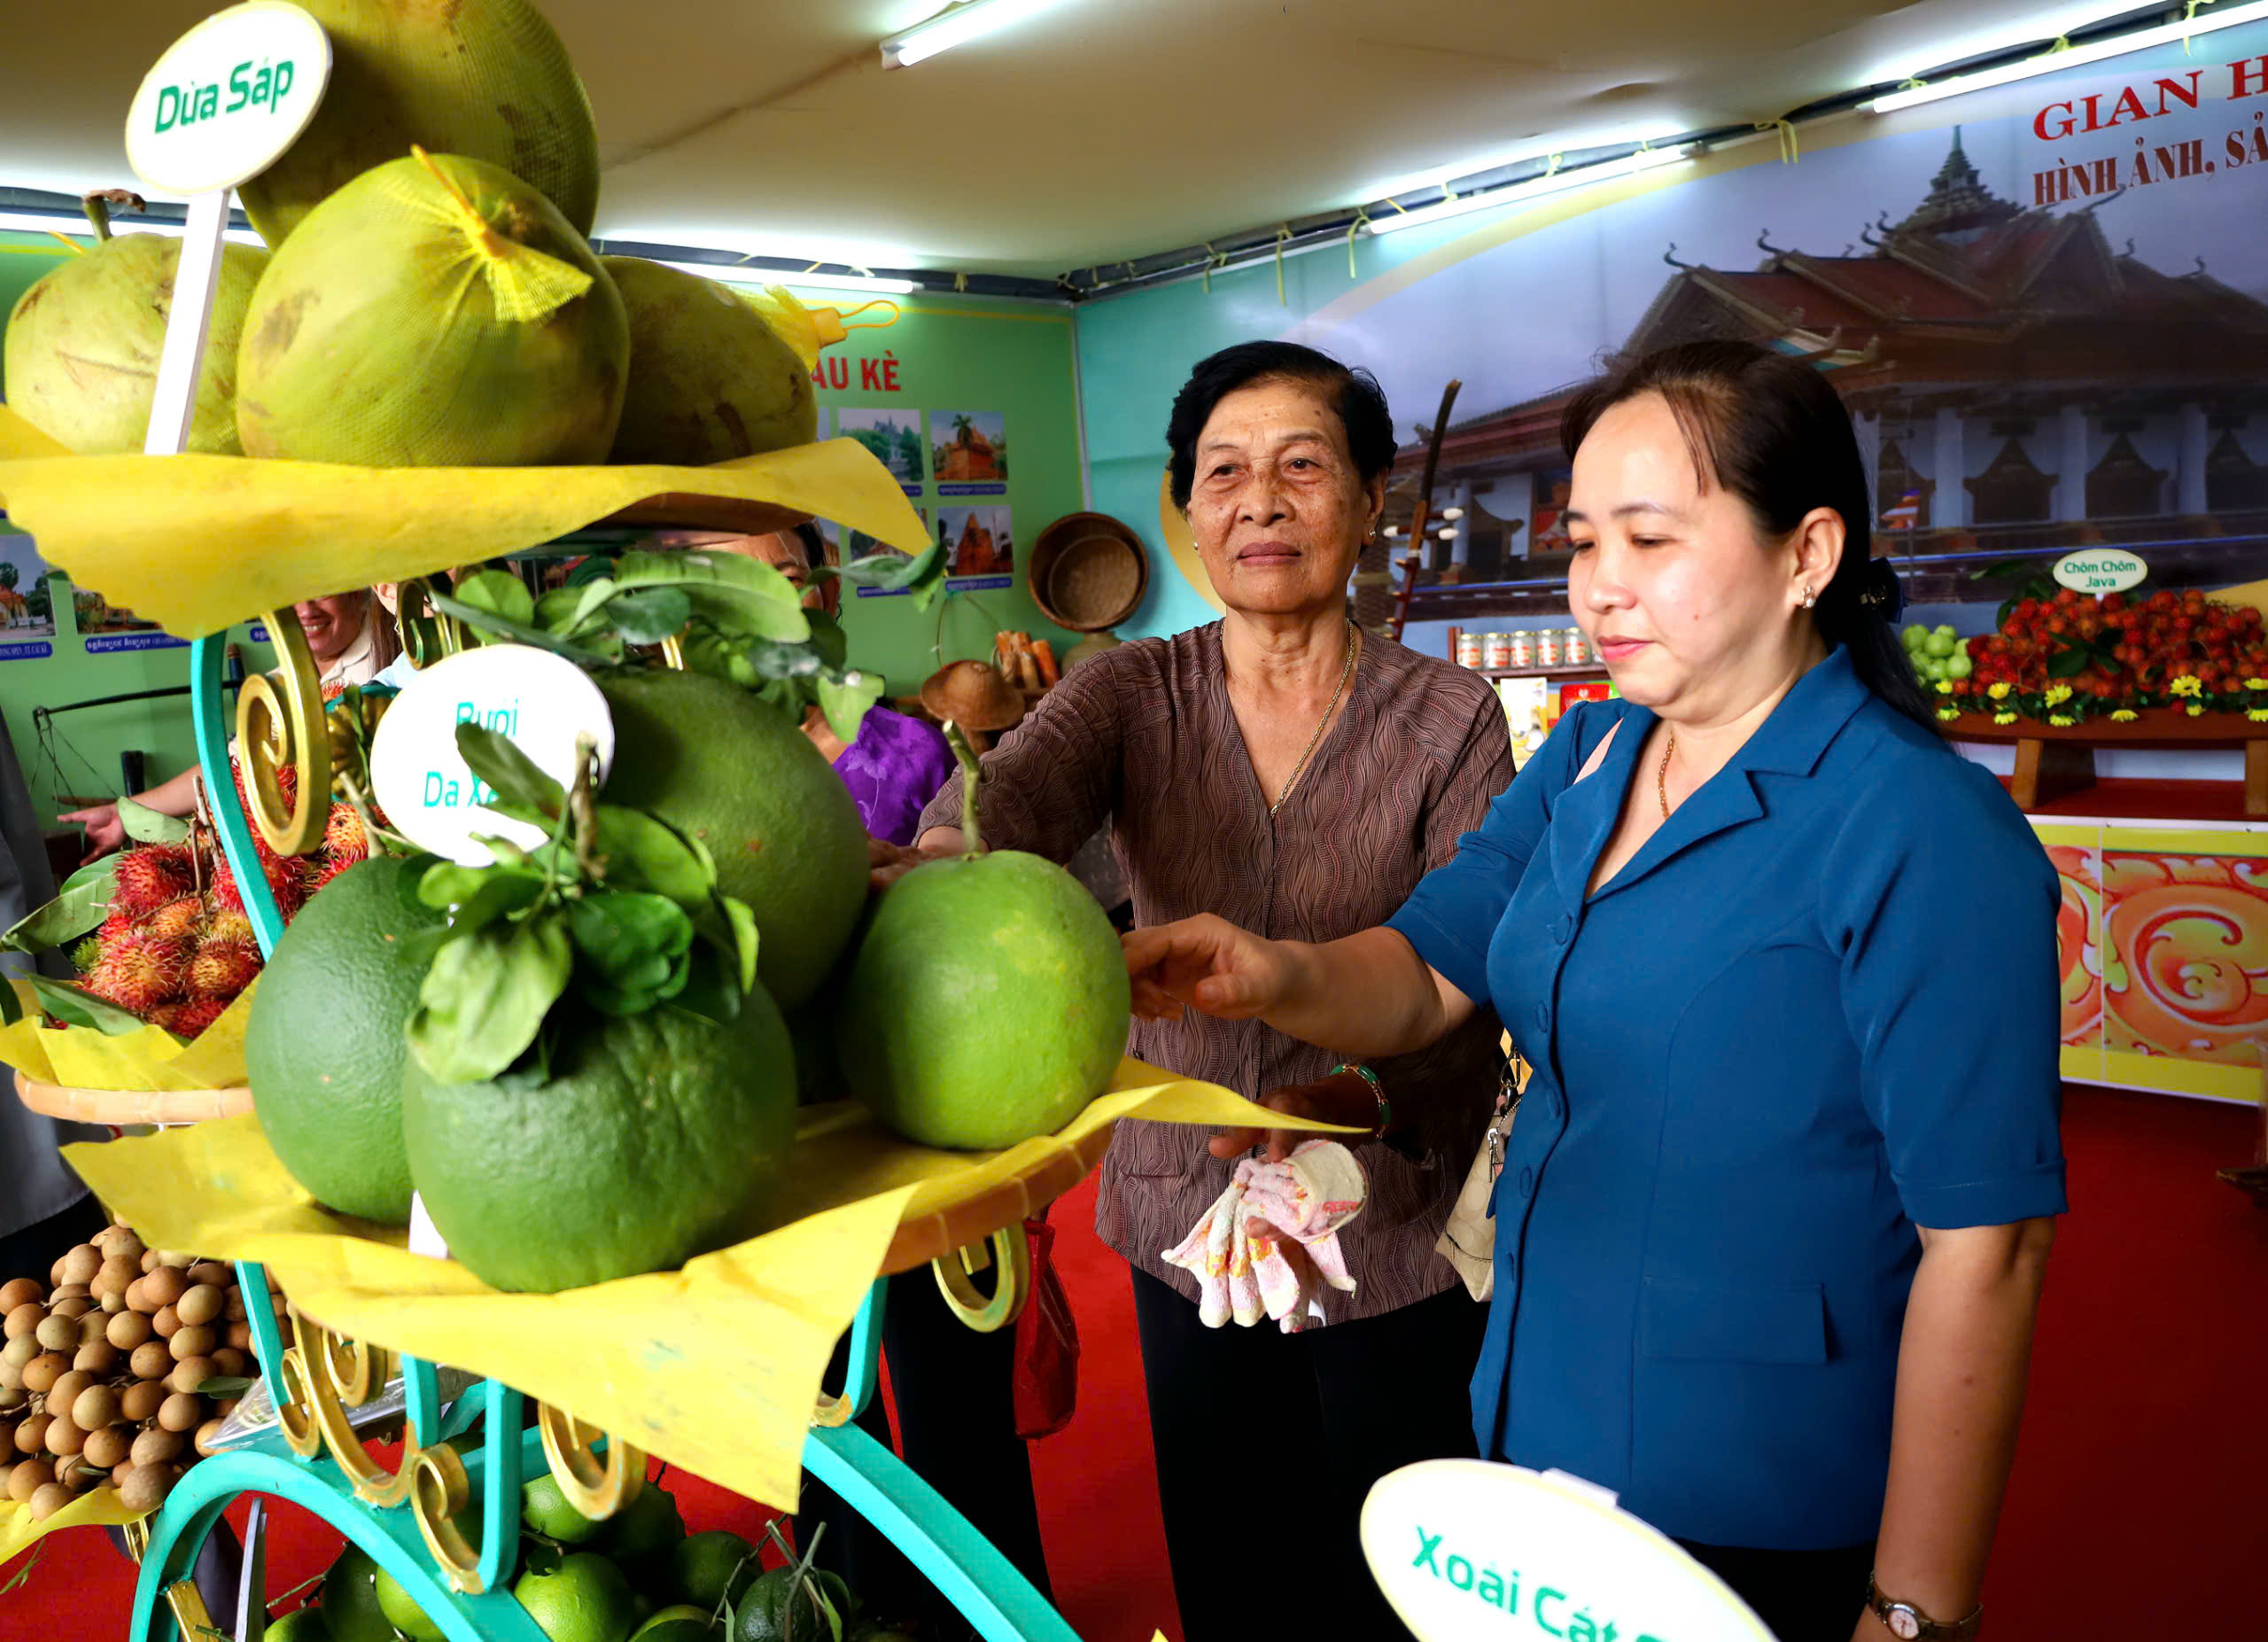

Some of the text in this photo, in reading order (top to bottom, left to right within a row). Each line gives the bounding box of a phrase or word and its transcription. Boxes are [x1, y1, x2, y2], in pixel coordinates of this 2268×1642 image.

[155, 80, 220, 135] Dừa
[2032, 70, 2203, 141] GIAN
[2032, 157, 2118, 206] HÌNH
[2129, 136, 2215, 188] ẢNH,
[811, 349, 901, 392] AU KÈ
[2085, 577, 2116, 588] Java
[2101, 560, 2136, 572] Chôm
[423, 771, 460, 807] Da
